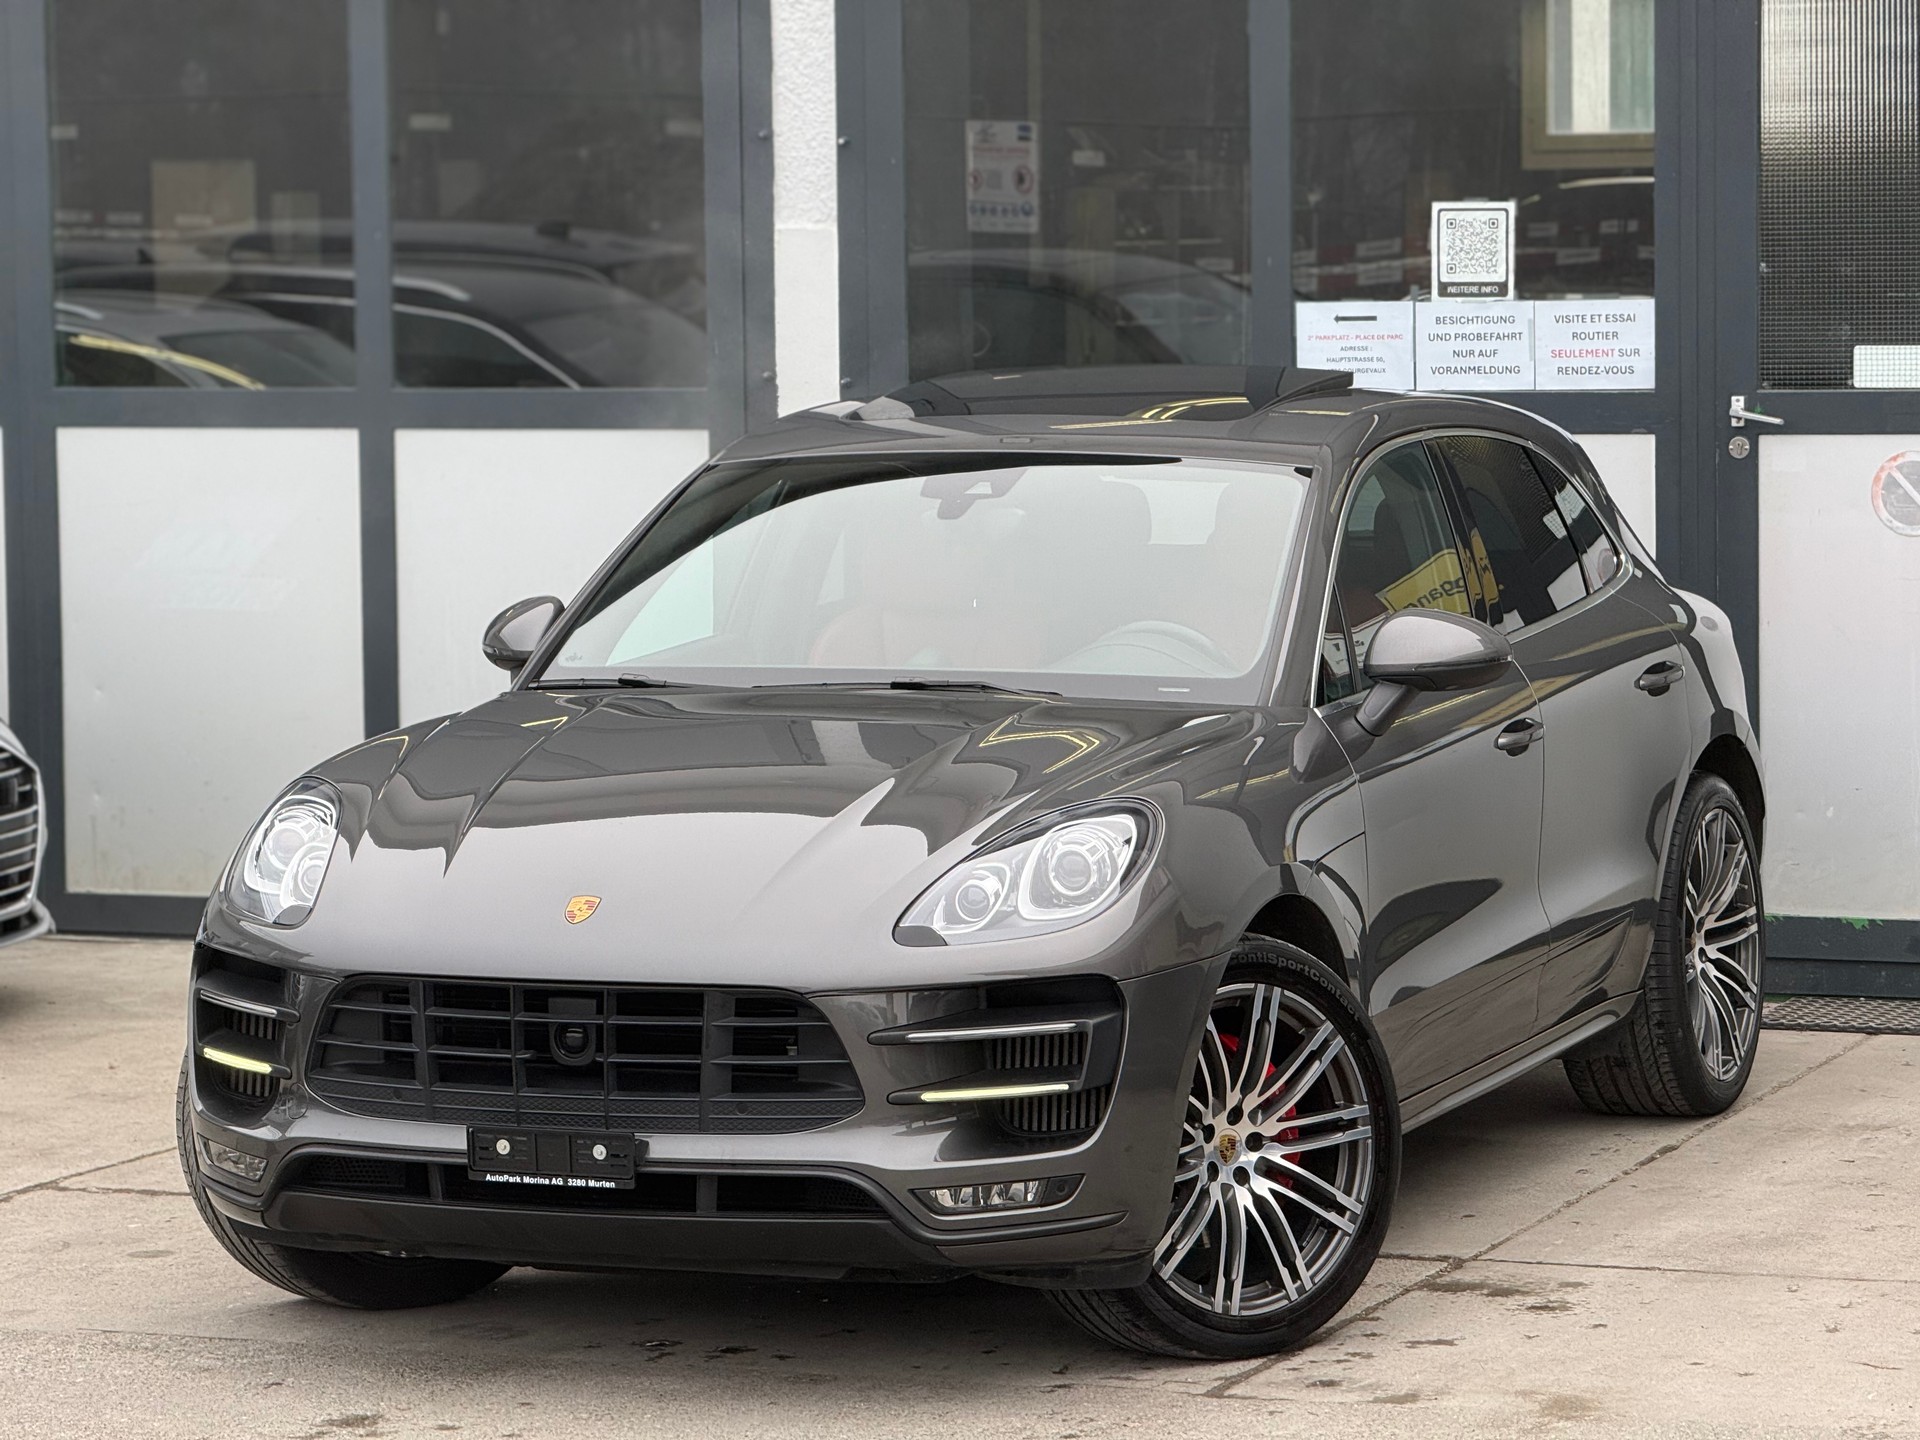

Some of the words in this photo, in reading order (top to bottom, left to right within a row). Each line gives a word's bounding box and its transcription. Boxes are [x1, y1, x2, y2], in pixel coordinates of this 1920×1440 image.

[1481, 285, 1499, 293] INFO
[1435, 315, 1516, 325] BESICHTIGUNG
[1554, 314, 1587, 323] VISITE
[1590, 314, 1602, 323] ET
[1605, 313, 1636, 322] ESSAI
[1428, 333, 1452, 342] UND
[1454, 332, 1523, 341] PROBEFAHRT
[1572, 331, 1619, 341] ROUTIER
[1453, 349, 1475, 358] NUR
[1478, 349, 1499, 358] AUF
[1551, 348, 1615, 358] SEULEMENT
[1618, 348, 1641, 357] SUR
[1430, 366, 1521, 375] VORANMELDUNG
[1557, 366, 1635, 375] RENDEZ-VOUS
[485, 1173, 521, 1183] AutoPark
[523, 1176, 550, 1185] Morina
[551, 1177, 563, 1185] AG
[567, 1178, 586, 1187] 3280
[588, 1179, 616, 1188] Murten
